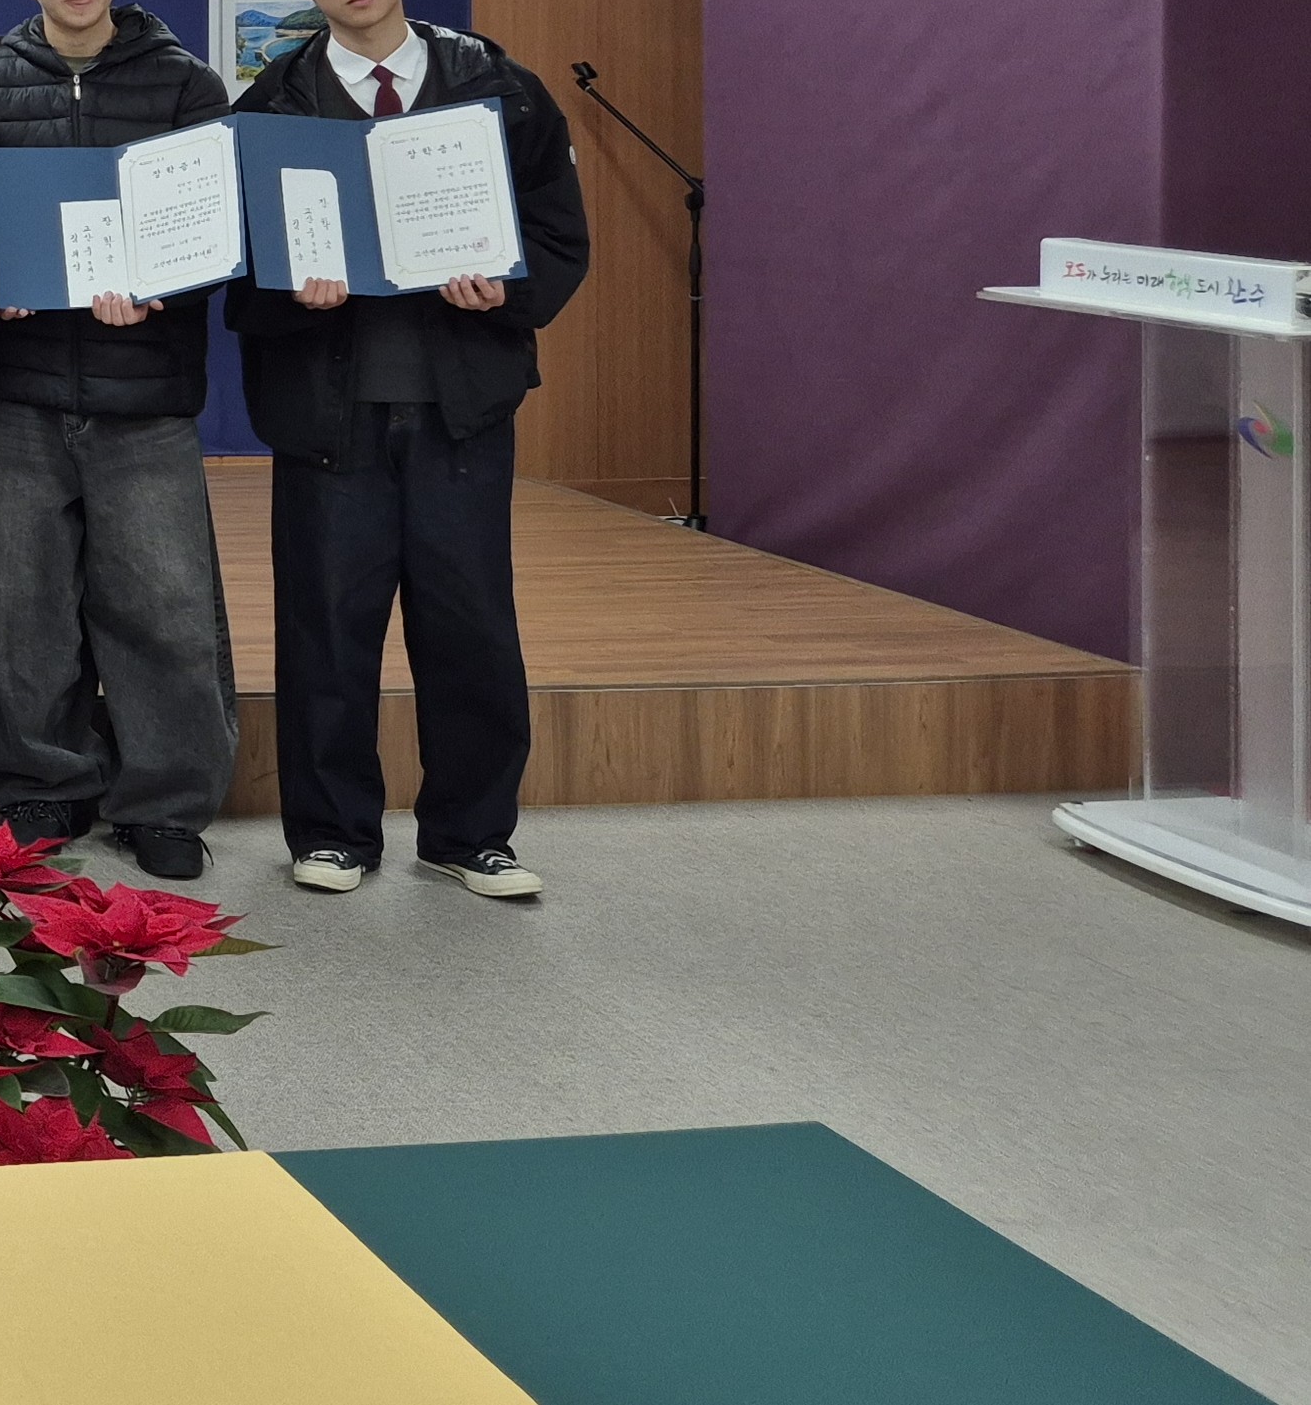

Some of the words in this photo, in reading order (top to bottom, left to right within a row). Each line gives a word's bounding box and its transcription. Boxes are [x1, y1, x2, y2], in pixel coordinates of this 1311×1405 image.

[1063, 261, 1097, 282] 모두가
[1100, 265, 1132, 285] 누리는
[1225, 278, 1265, 307] 완주
